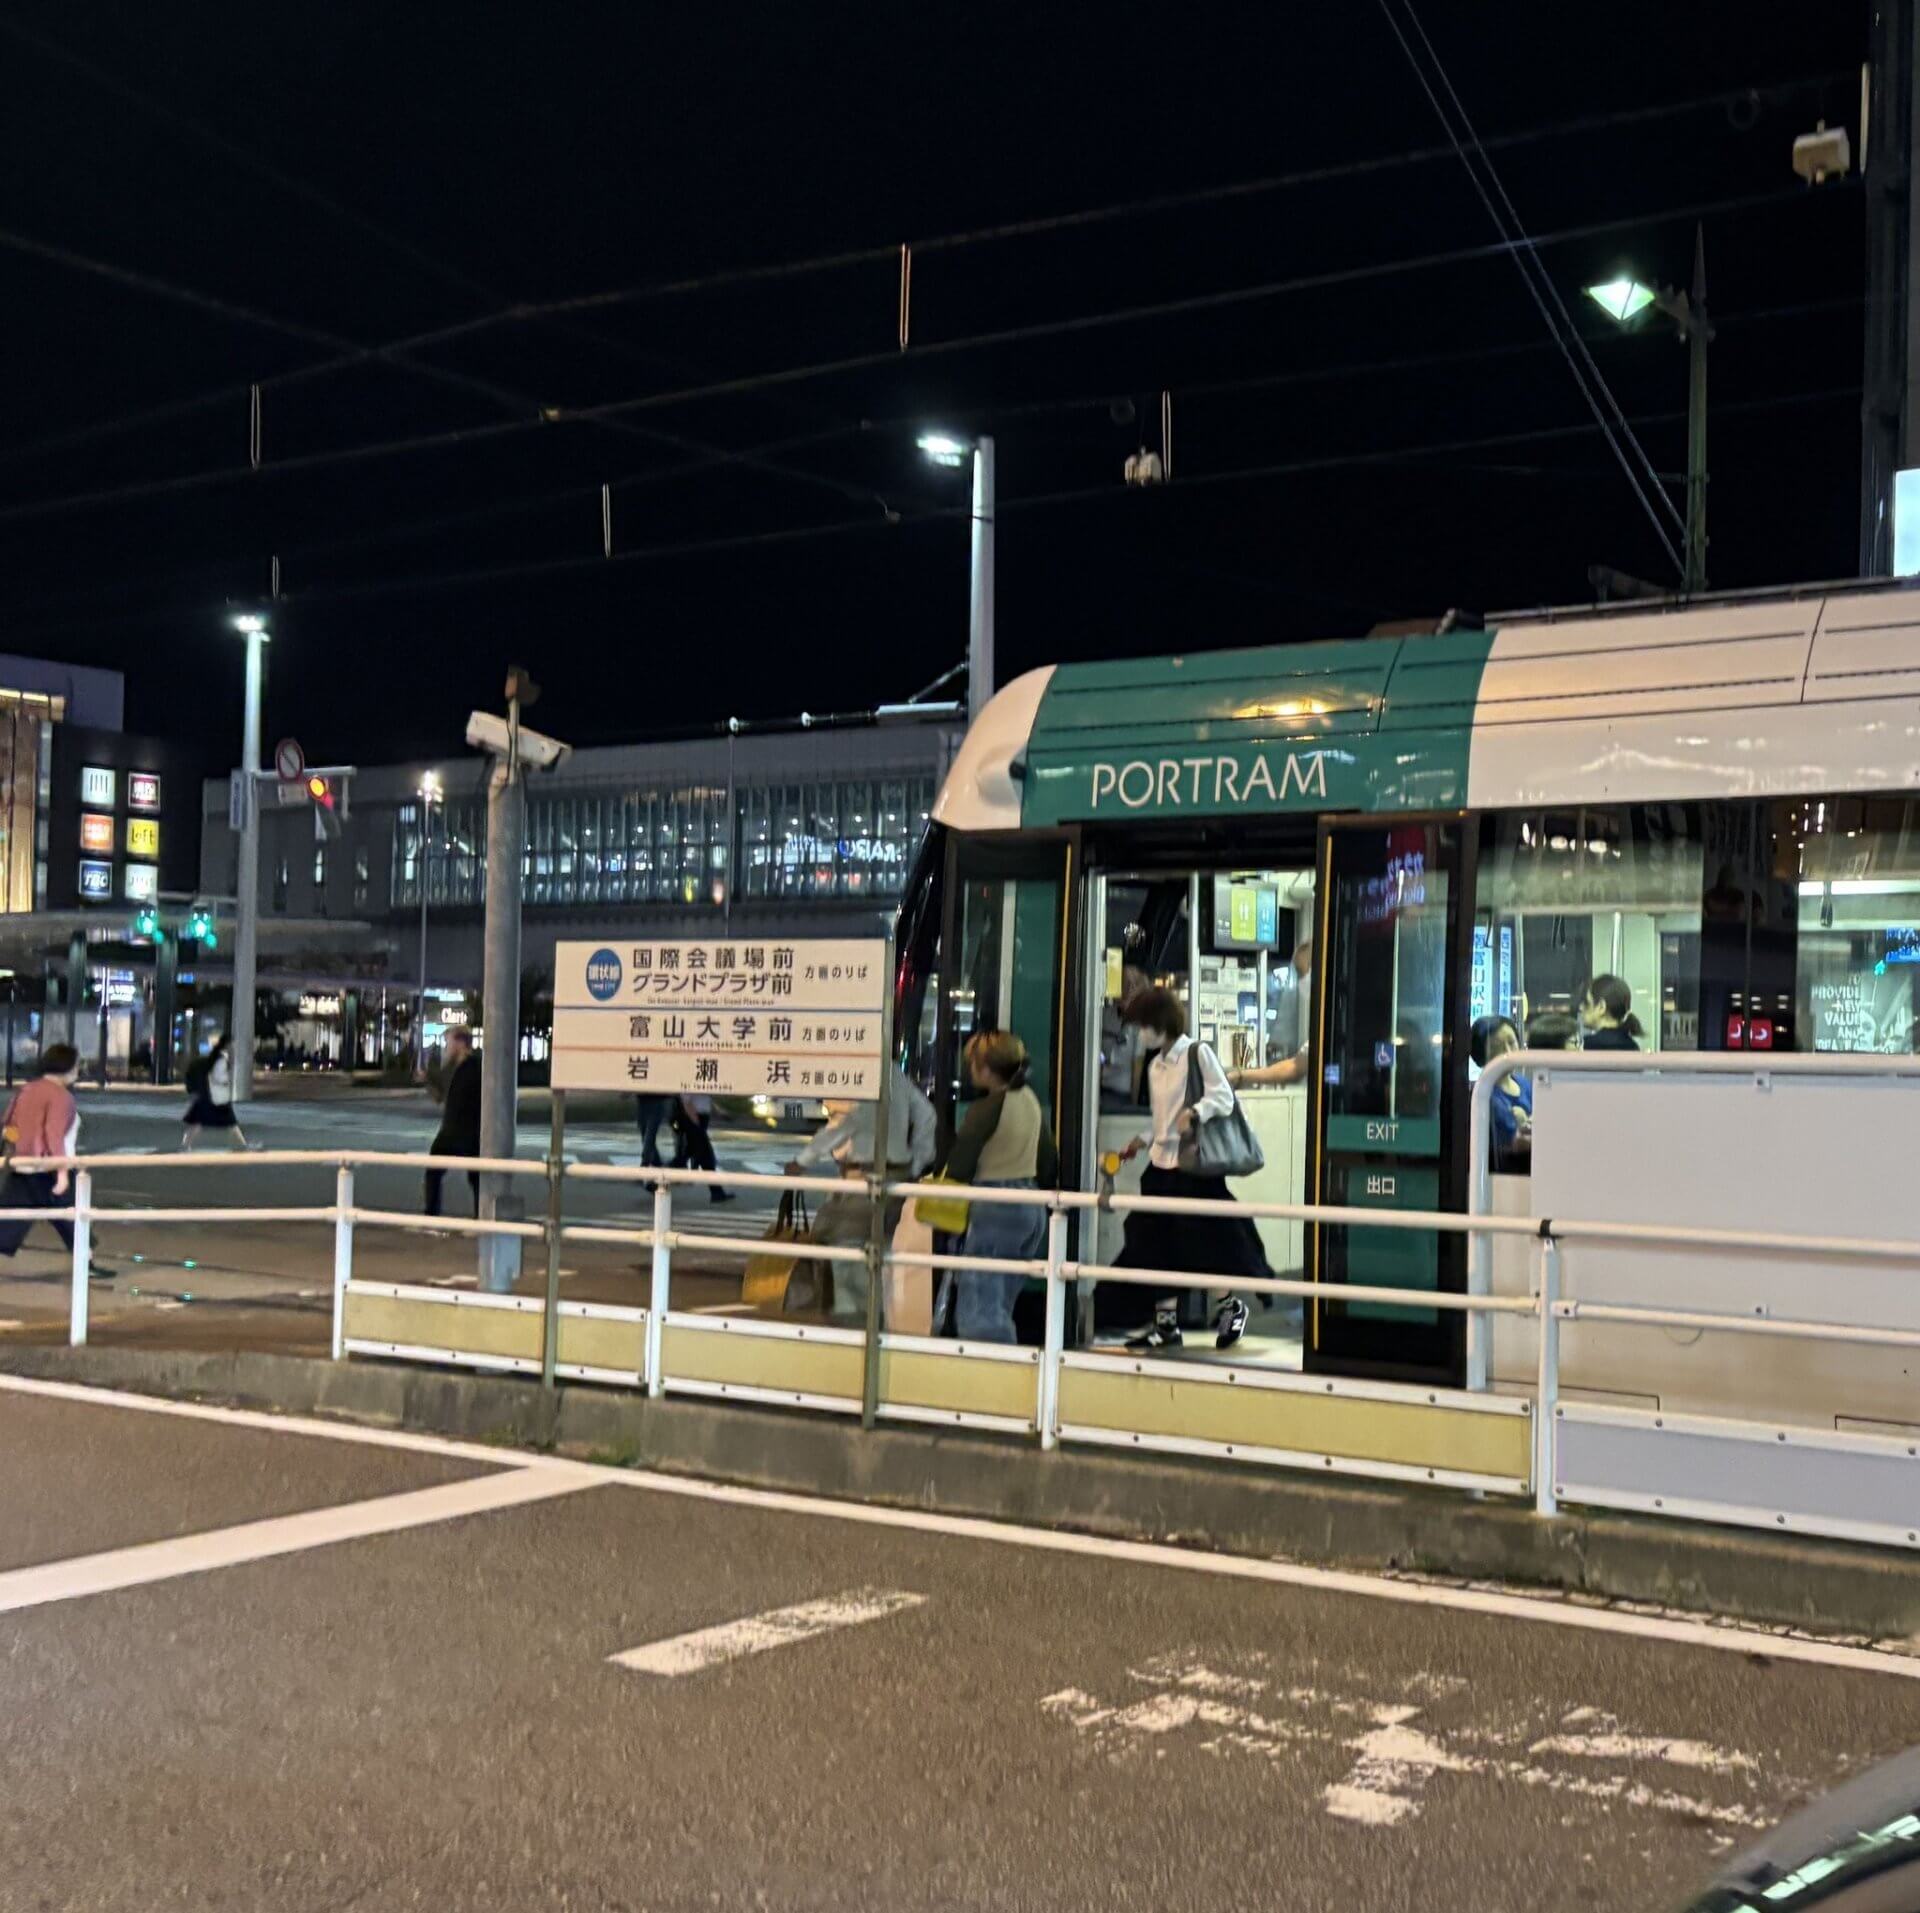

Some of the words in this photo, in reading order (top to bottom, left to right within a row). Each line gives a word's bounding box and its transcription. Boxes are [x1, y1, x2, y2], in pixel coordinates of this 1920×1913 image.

[1092, 752, 1327, 808] PORTRAM
[633, 972, 793, 994] グランドプラザ前
[630, 1015, 792, 1041] 富山大学前
[628, 1055, 791, 1084] 岩瀬浜
[1366, 1121, 1399, 1142] EXIT
[1367, 1174, 1395, 1195] 出口
